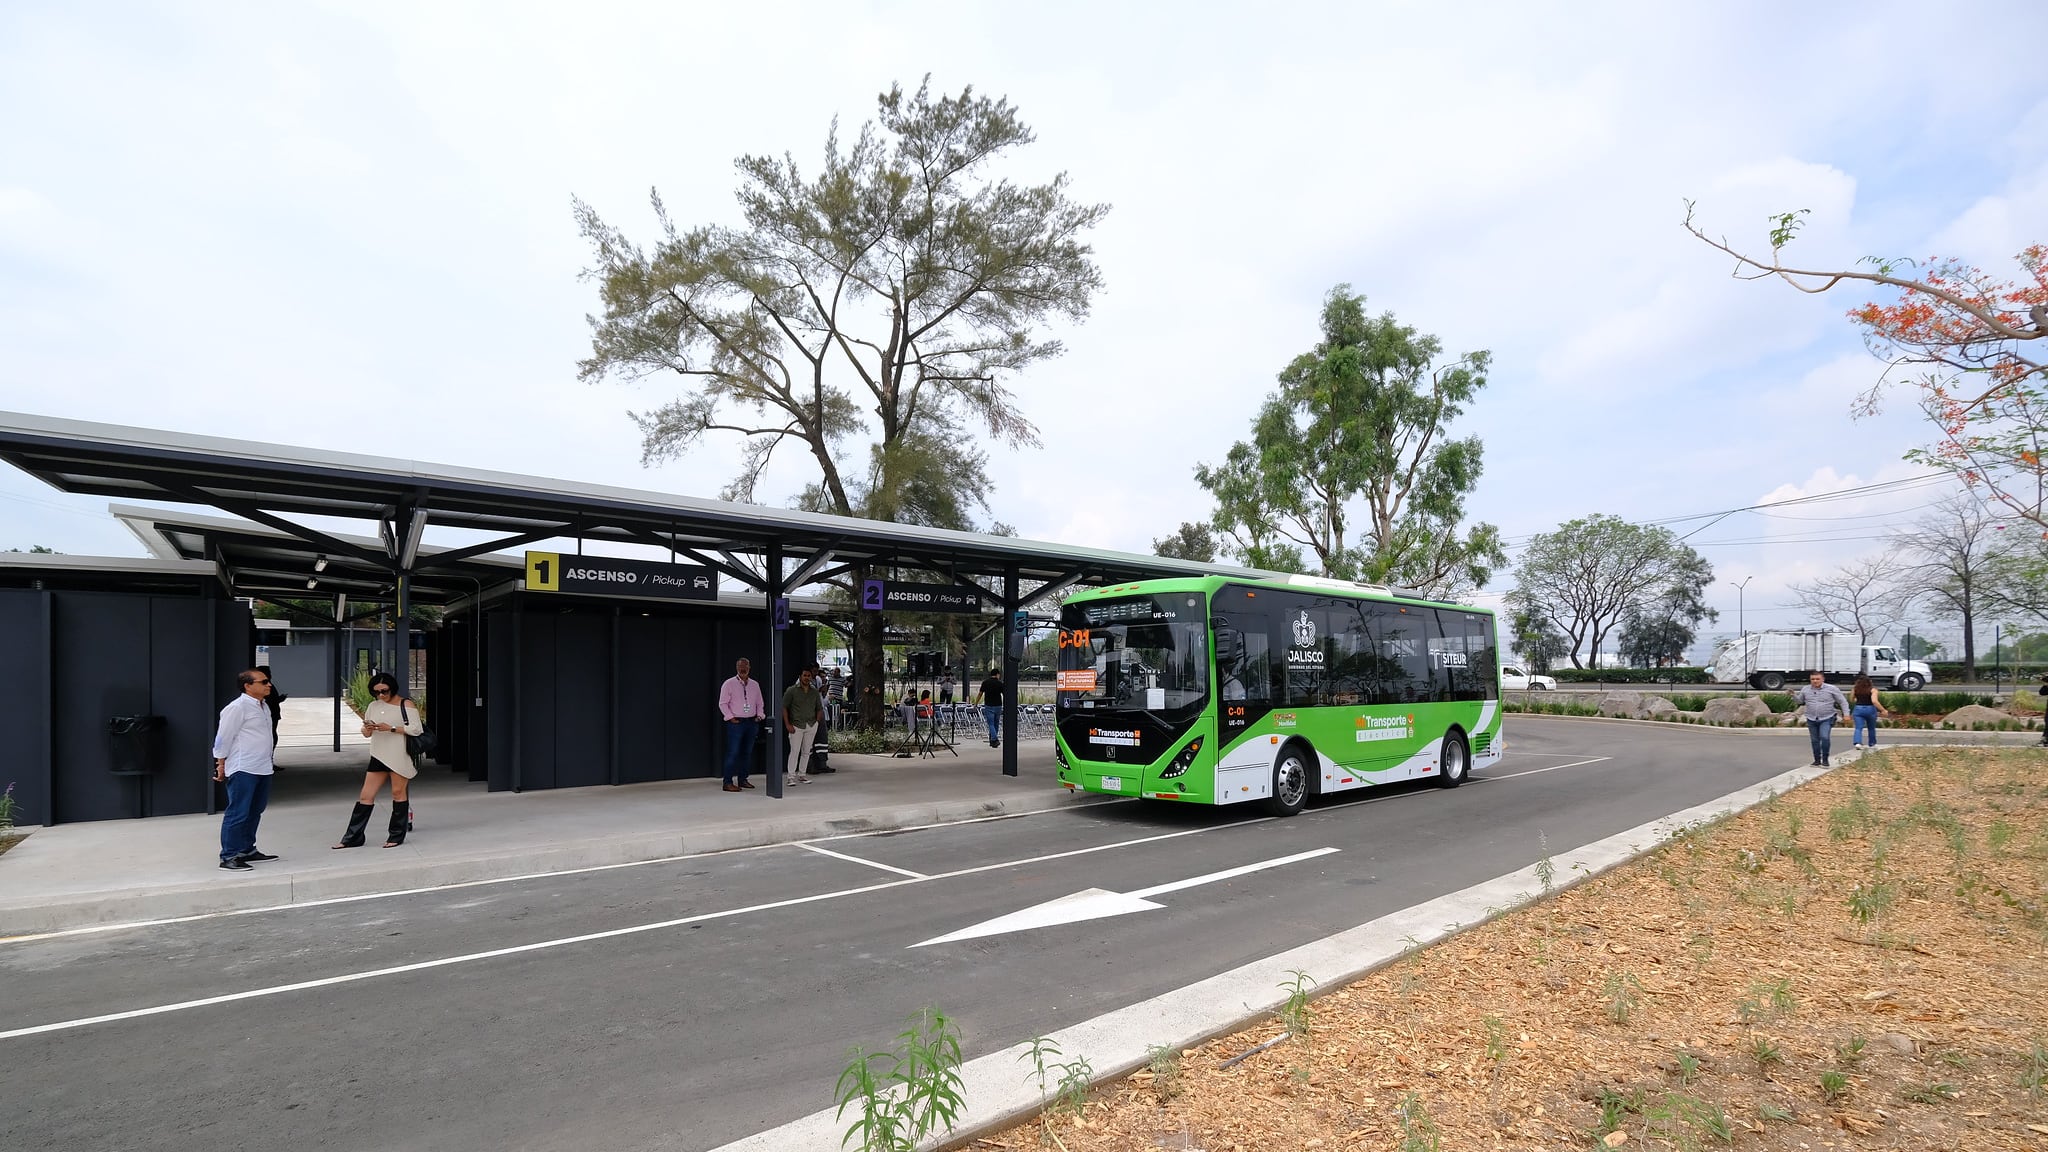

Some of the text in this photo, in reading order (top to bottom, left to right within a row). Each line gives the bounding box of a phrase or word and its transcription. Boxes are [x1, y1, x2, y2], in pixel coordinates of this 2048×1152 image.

[534, 560, 550, 584] 1
[566, 568, 637, 583] ASCENSO
[652, 575, 686, 586] Pickup
[866, 586, 880, 605] 2
[887, 591, 931, 602] ASCENSO
[940, 595, 962, 604] Pickup
[776, 605, 785, 625] 2
[1059, 629, 1090, 648] C-01
[1288, 650, 1324, 662] JALISCO
[1442, 652, 1467, 665] SITEUR
[1228, 706, 1245, 716] C-01
[1366, 715, 1407, 728] Transporte
[1097, 729, 1135, 738] Transporte
